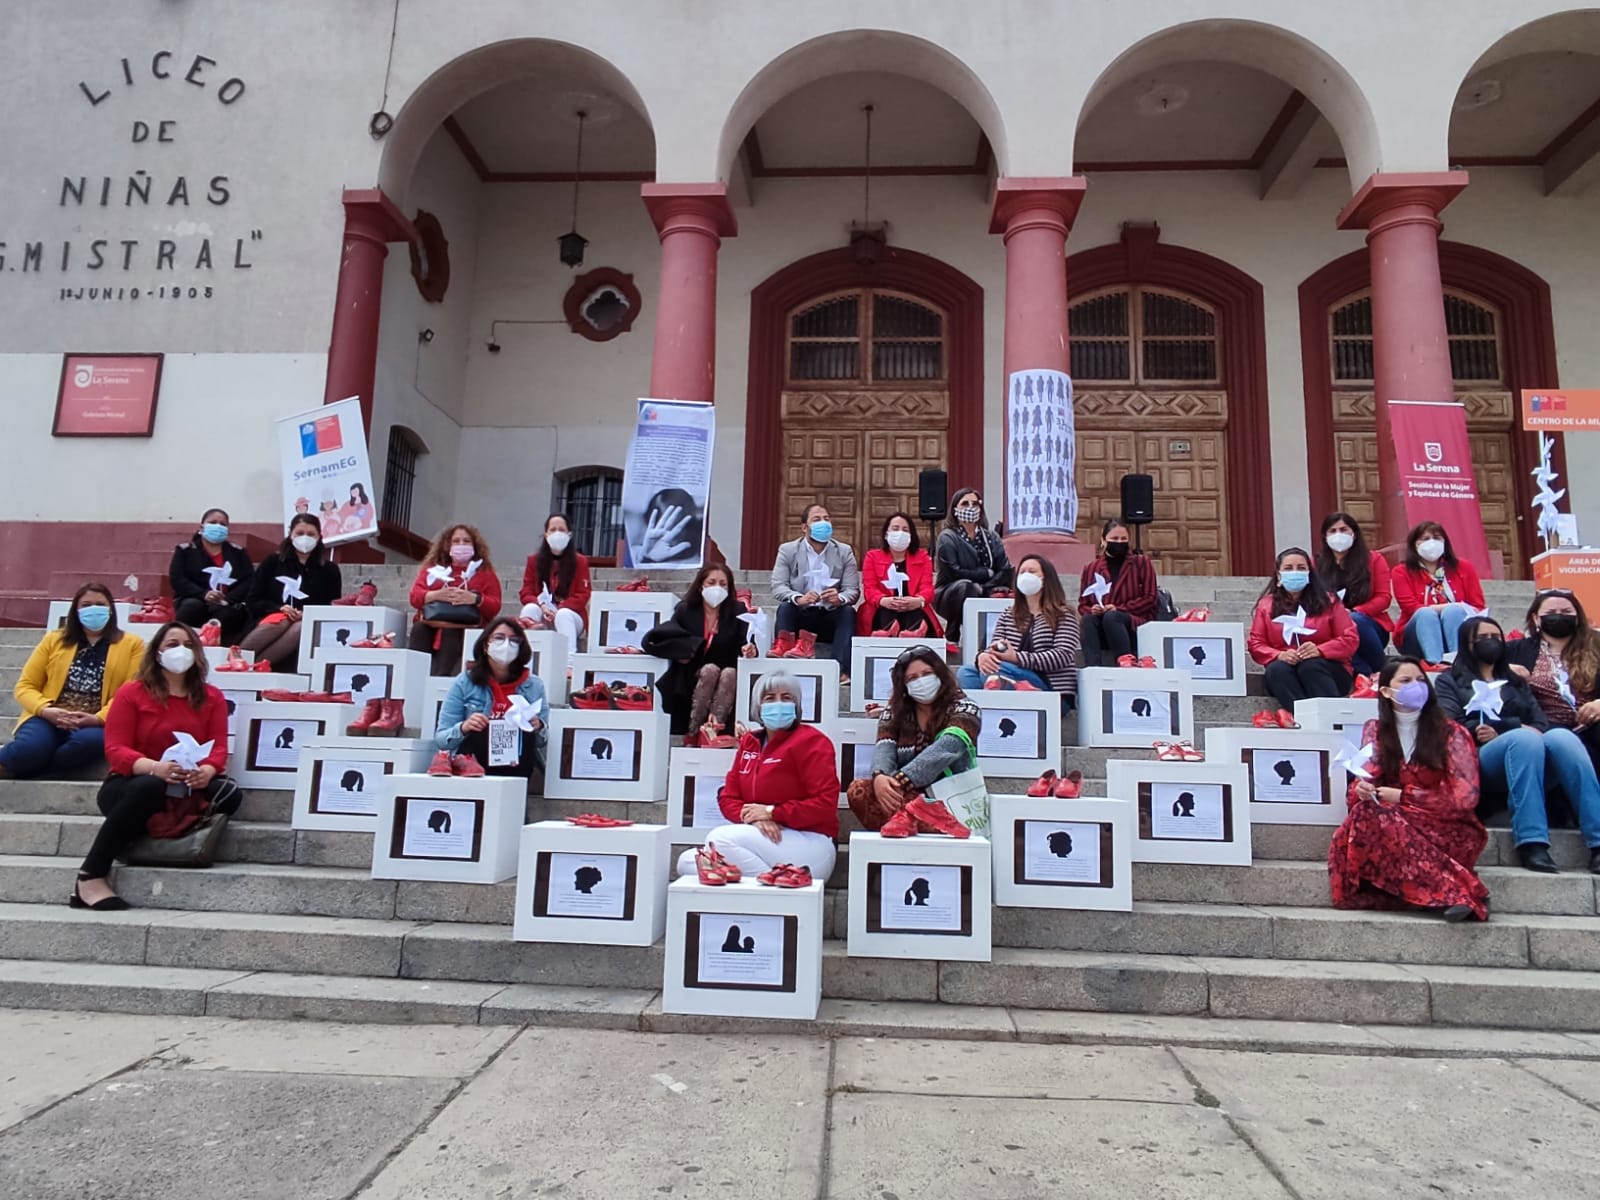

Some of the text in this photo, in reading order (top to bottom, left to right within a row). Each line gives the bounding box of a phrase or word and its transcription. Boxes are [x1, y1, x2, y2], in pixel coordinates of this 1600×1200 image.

[78, 50, 246, 106] LICEO
[131, 120, 177, 144] DE
[59, 170, 231, 207] NIÑAS
[1527, 417, 1561, 425] CENTRO
[1562, 417, 1574, 425] DE
[1575, 417, 1587, 425] LA
[293, 455, 357, 481] SernamEG
[1413, 462, 1461, 473] La Serena
